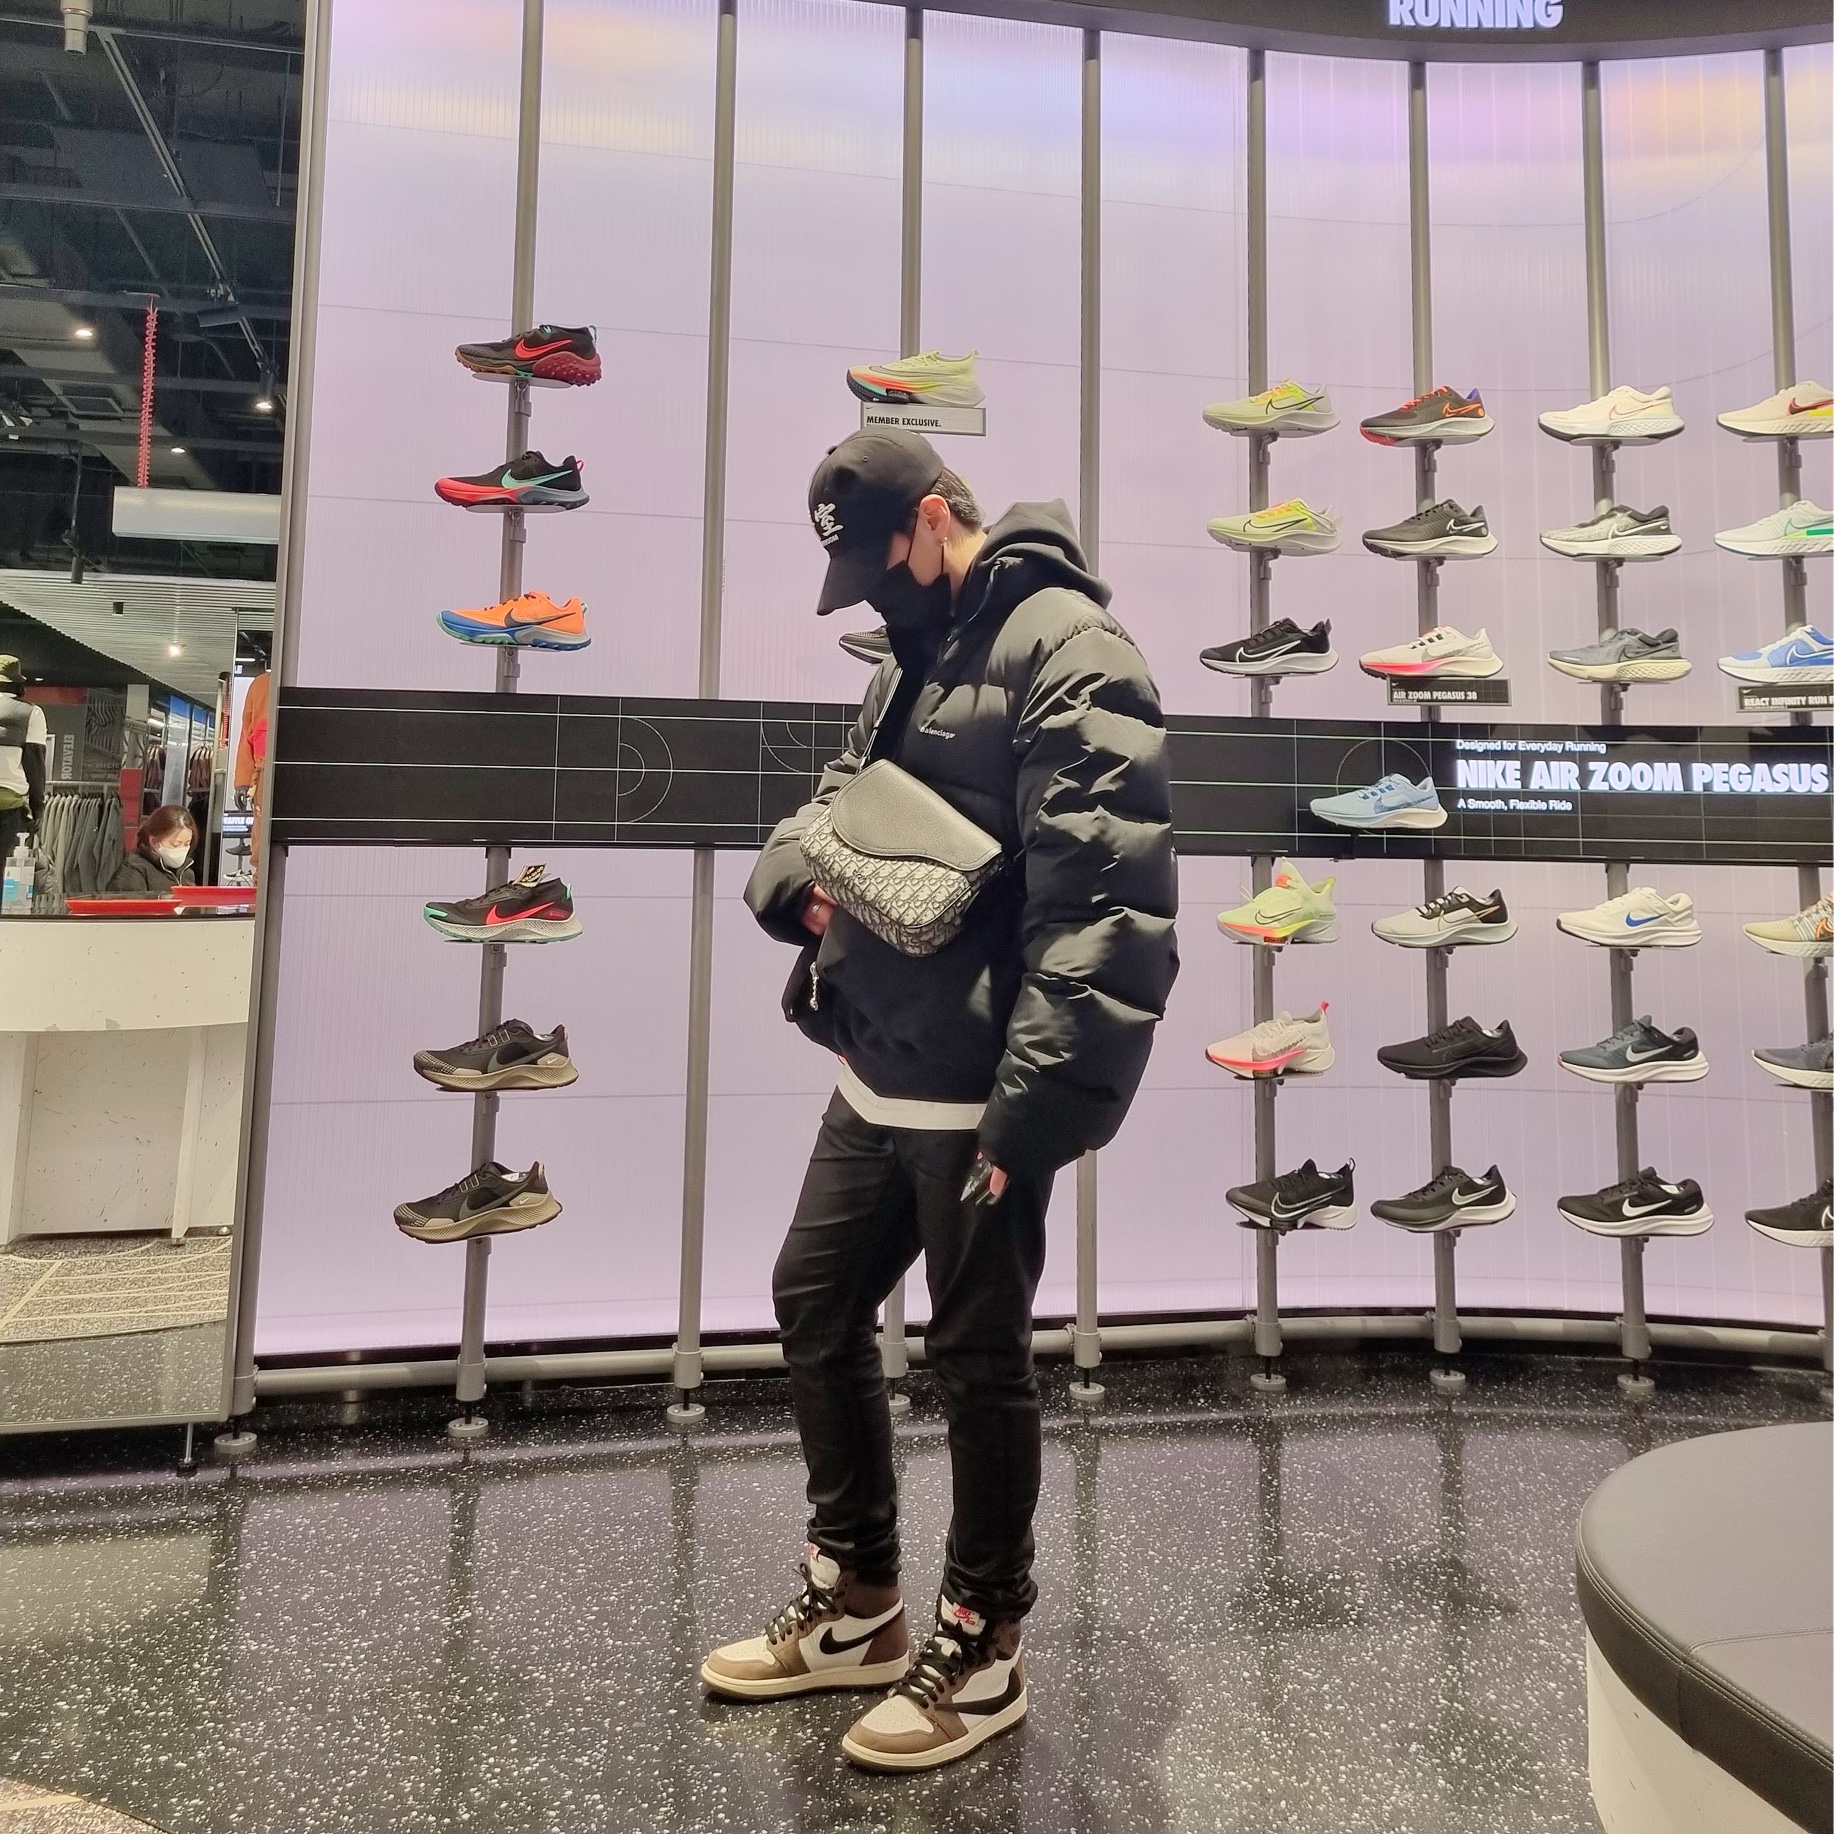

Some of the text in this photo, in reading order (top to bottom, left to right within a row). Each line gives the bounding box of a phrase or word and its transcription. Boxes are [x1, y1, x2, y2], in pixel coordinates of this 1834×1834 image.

[1388, 0, 1563, 29] RUNNING
[866, 416, 942, 427] MEMBER EXCLUSIVE.
[1393, 691, 1478, 700] AIR ZOOM PEGASUS 38
[1744, 697, 1770, 706] REACT
[1771, 696, 1806, 706] INFINITY
[1808, 695, 1827, 705] RUN
[1456, 740, 1607, 754] Designed for Everyday Running
[1457, 759, 1829, 793] NIKE AIR ZOOM PEGASUS
[1457, 798, 1573, 811] A Smooth, Flexible Ride
